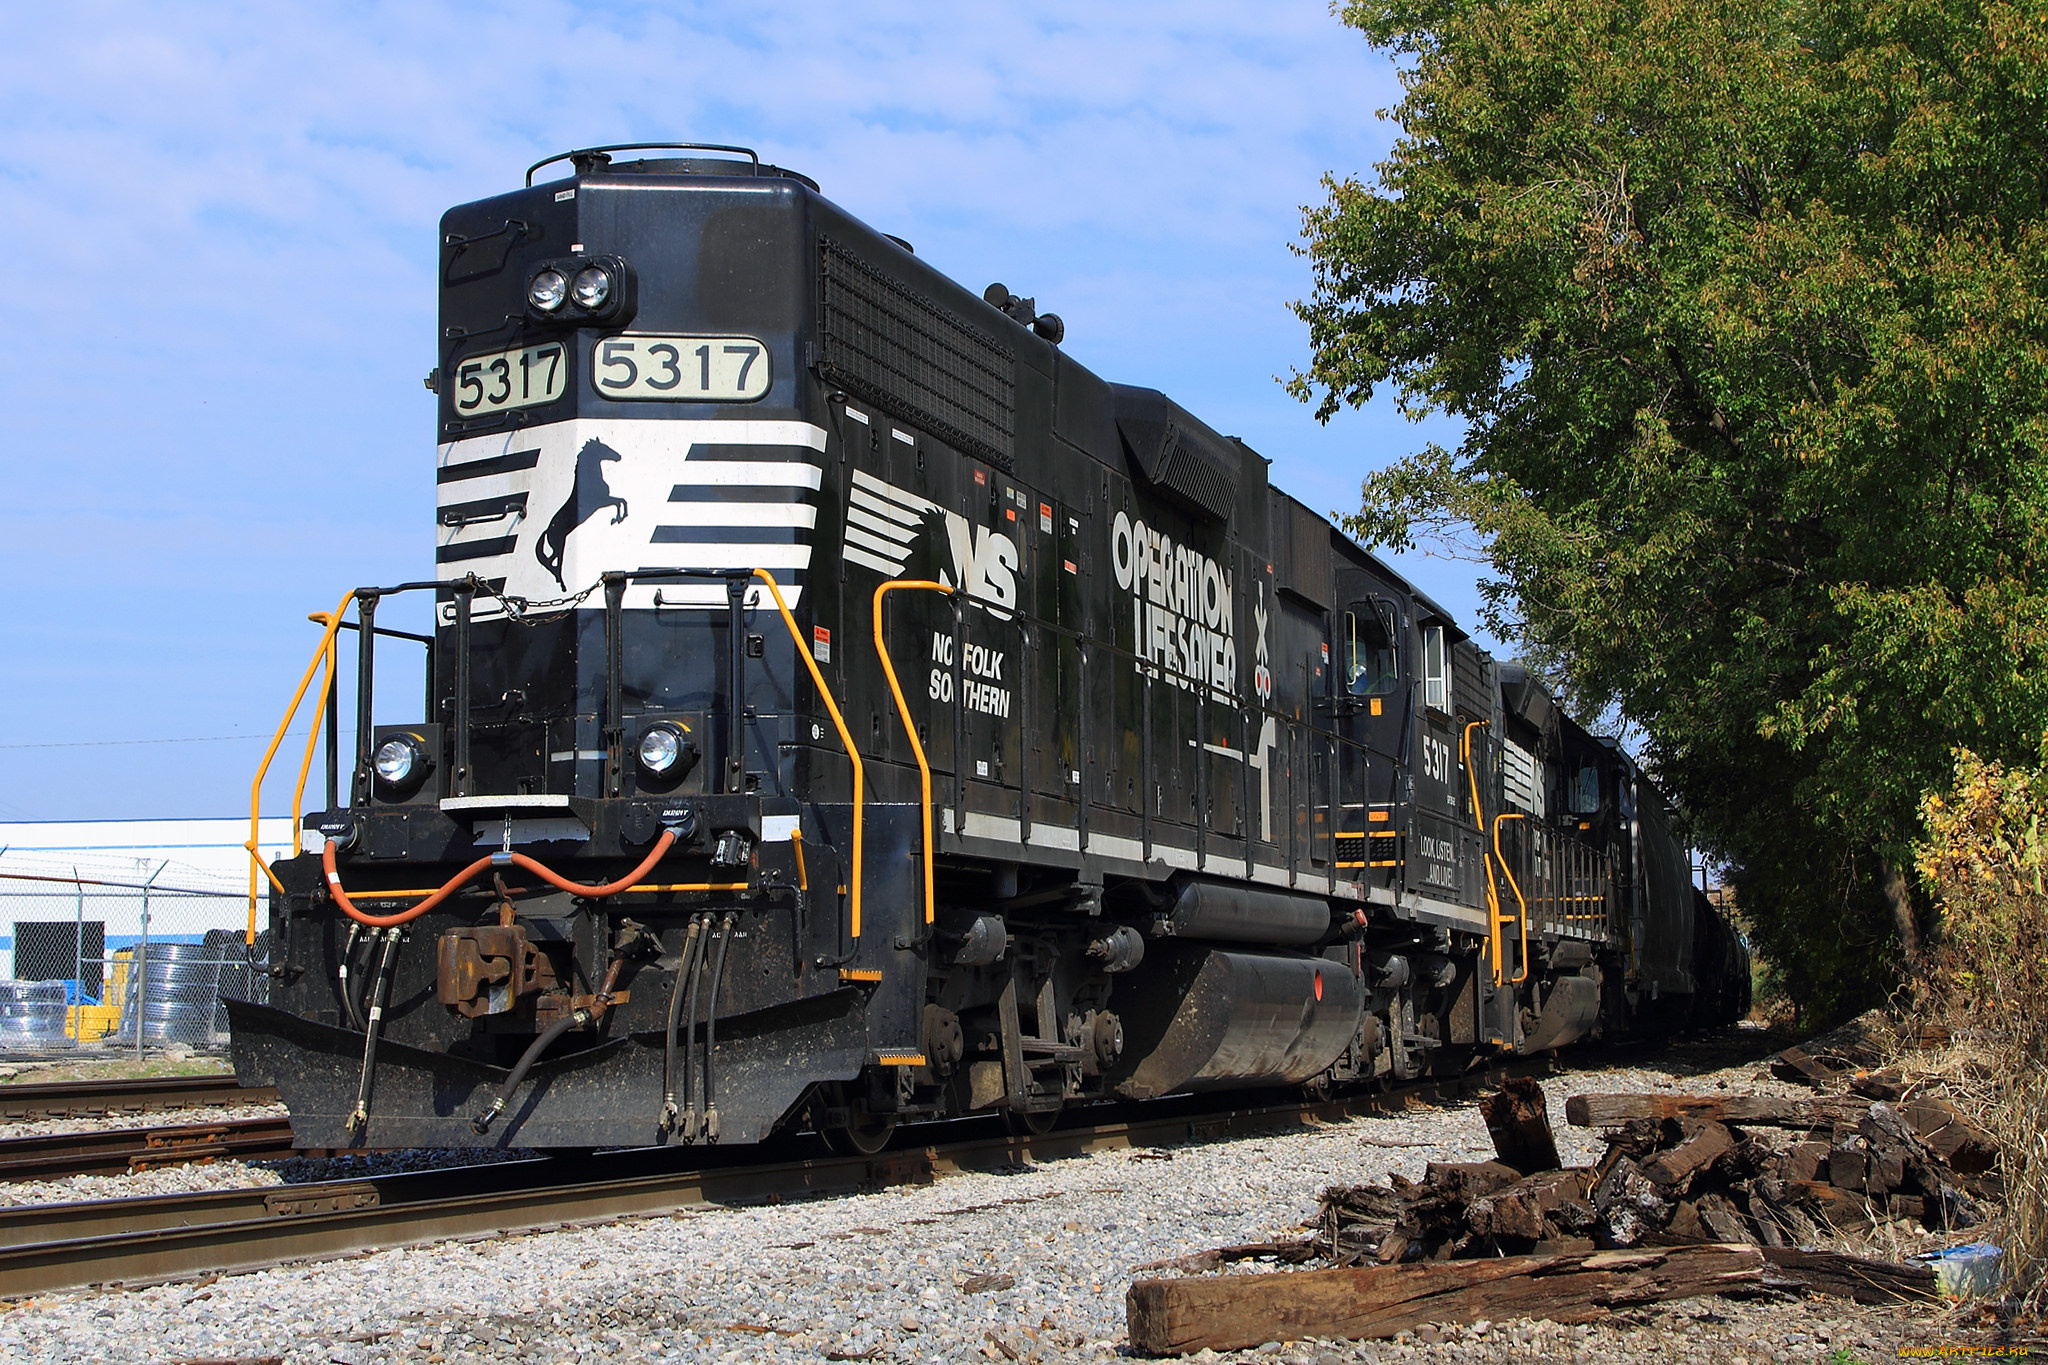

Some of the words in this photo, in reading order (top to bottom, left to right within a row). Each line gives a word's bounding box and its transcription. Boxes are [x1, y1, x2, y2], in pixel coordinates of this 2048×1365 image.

[459, 346, 561, 410] 5317
[600, 343, 760, 391] 5317
[938, 509, 1019, 622] NS
[1112, 510, 1234, 637] OPERATION
[931, 631, 1004, 681] NOFOLK
[1133, 597, 1239, 709] LIFESAVER
[928, 668, 1010, 719] SOTHERN
[1422, 735, 1450, 785] 5317
[1420, 835, 1436, 862] LOOK,
